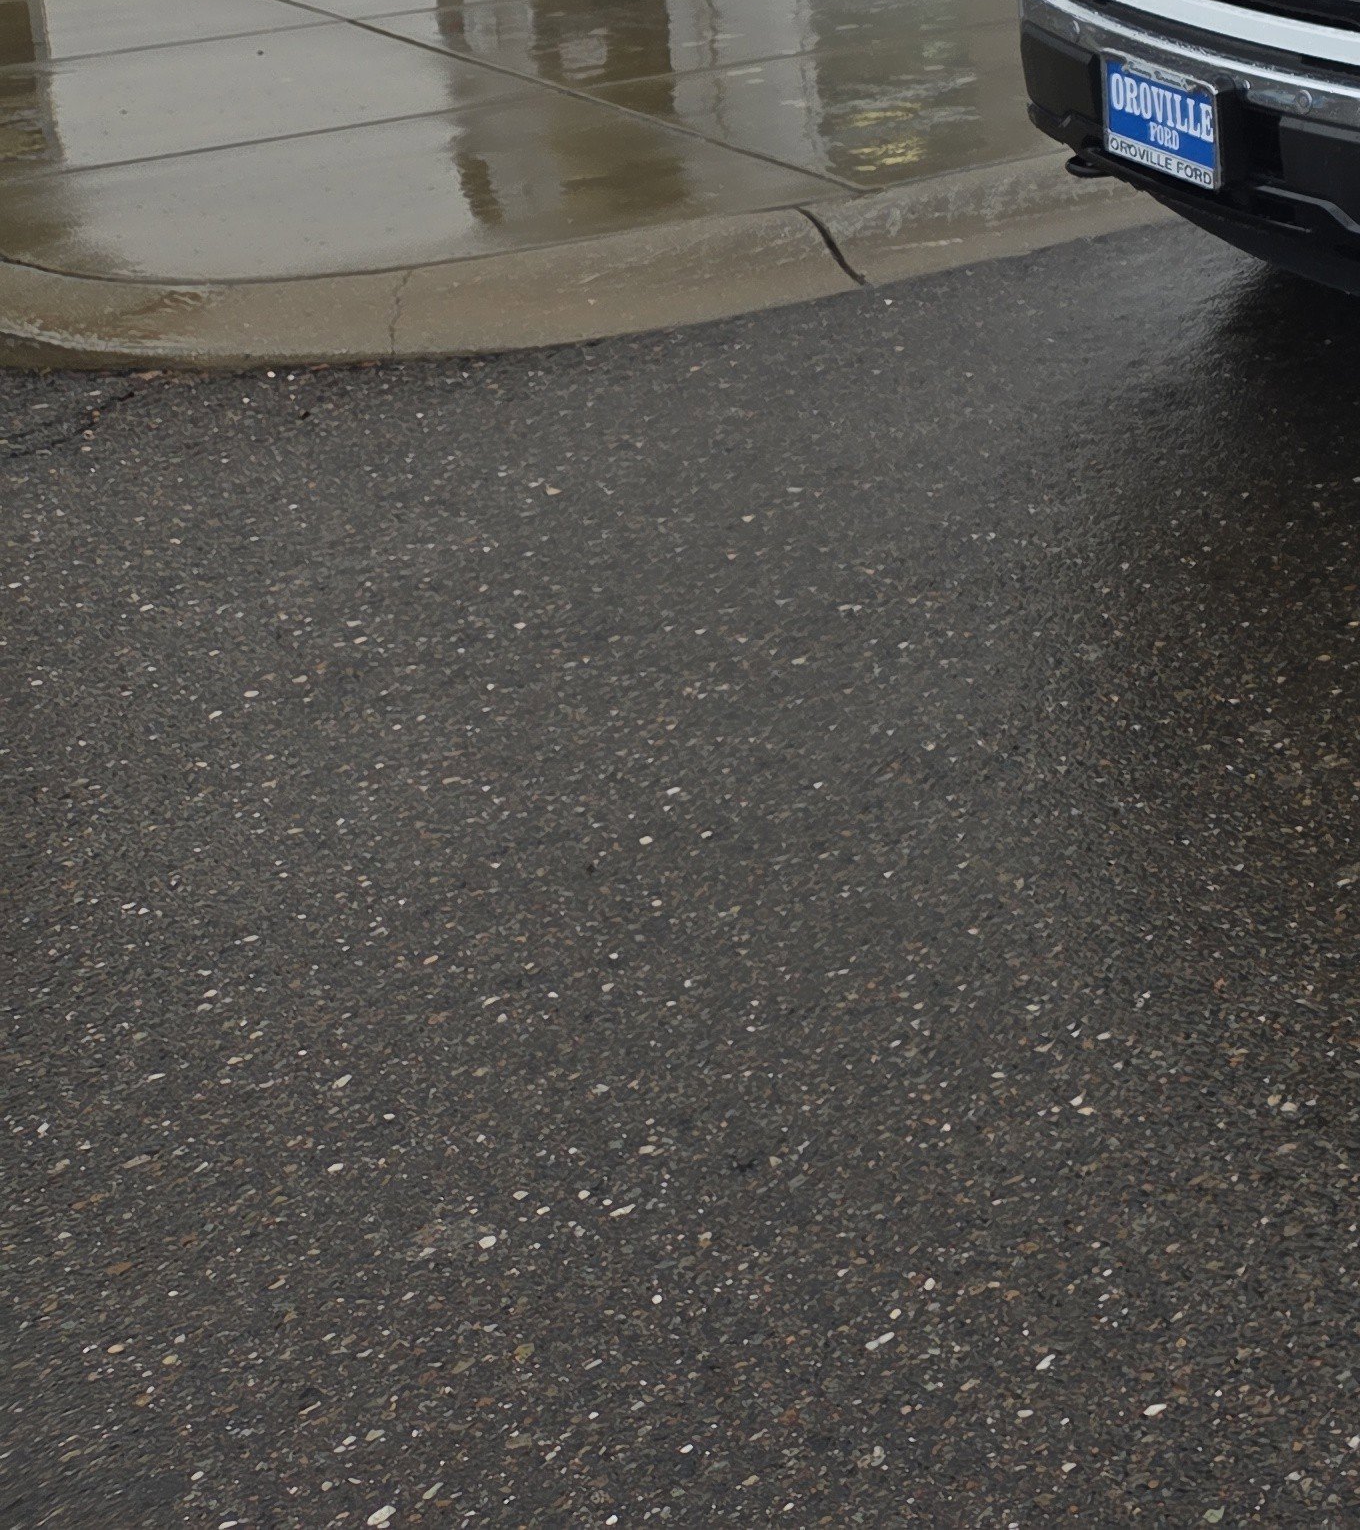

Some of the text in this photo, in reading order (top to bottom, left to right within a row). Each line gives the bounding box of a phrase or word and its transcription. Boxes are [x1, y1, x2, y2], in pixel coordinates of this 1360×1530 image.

[1110, 72, 1214, 143] OROVILLE
[1110, 136, 1213, 186] OROVILLE FORD
[1149, 122, 1180, 151] FORD
